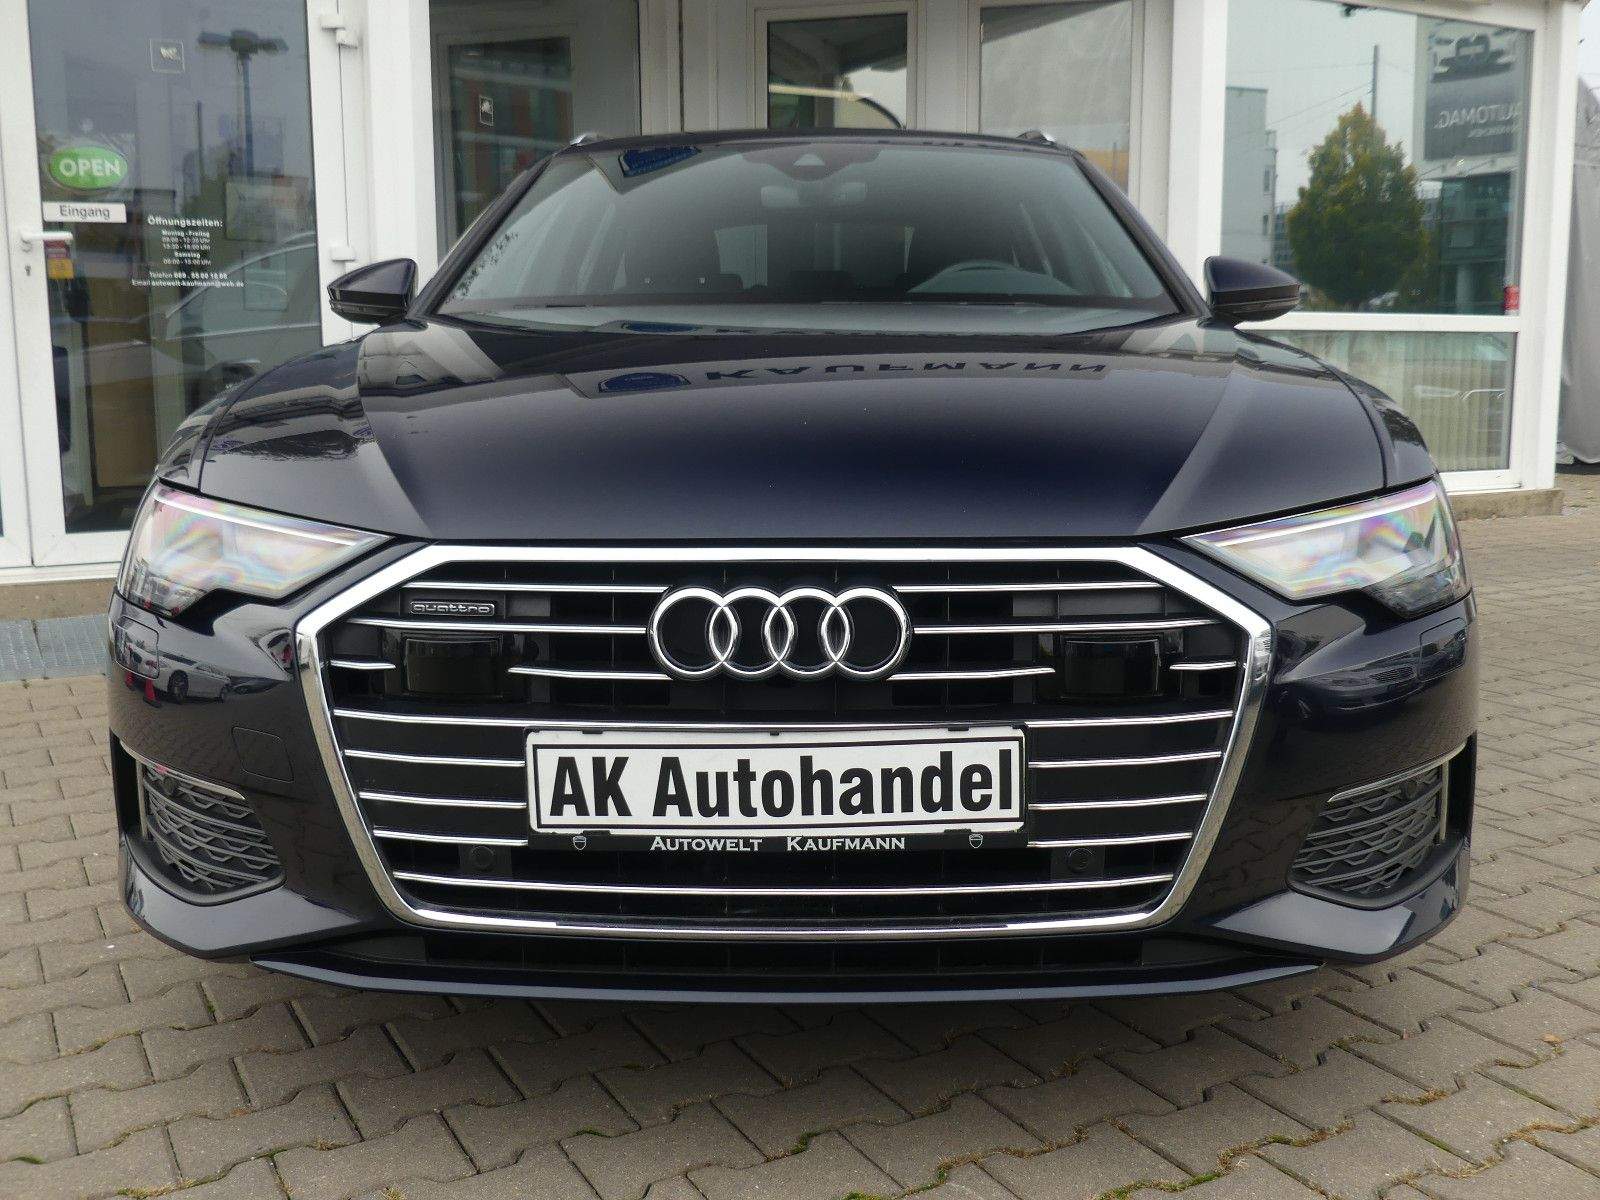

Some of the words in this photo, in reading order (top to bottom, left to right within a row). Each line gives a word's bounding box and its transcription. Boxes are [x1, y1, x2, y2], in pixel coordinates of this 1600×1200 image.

[59, 157, 122, 178] OPEN
[59, 204, 111, 222] Eingang
[147, 214, 223, 228] Öffnungszeiten:
[412, 603, 491, 615] quattro
[549, 755, 633, 818] AK
[652, 748, 1013, 819] Autohandel
